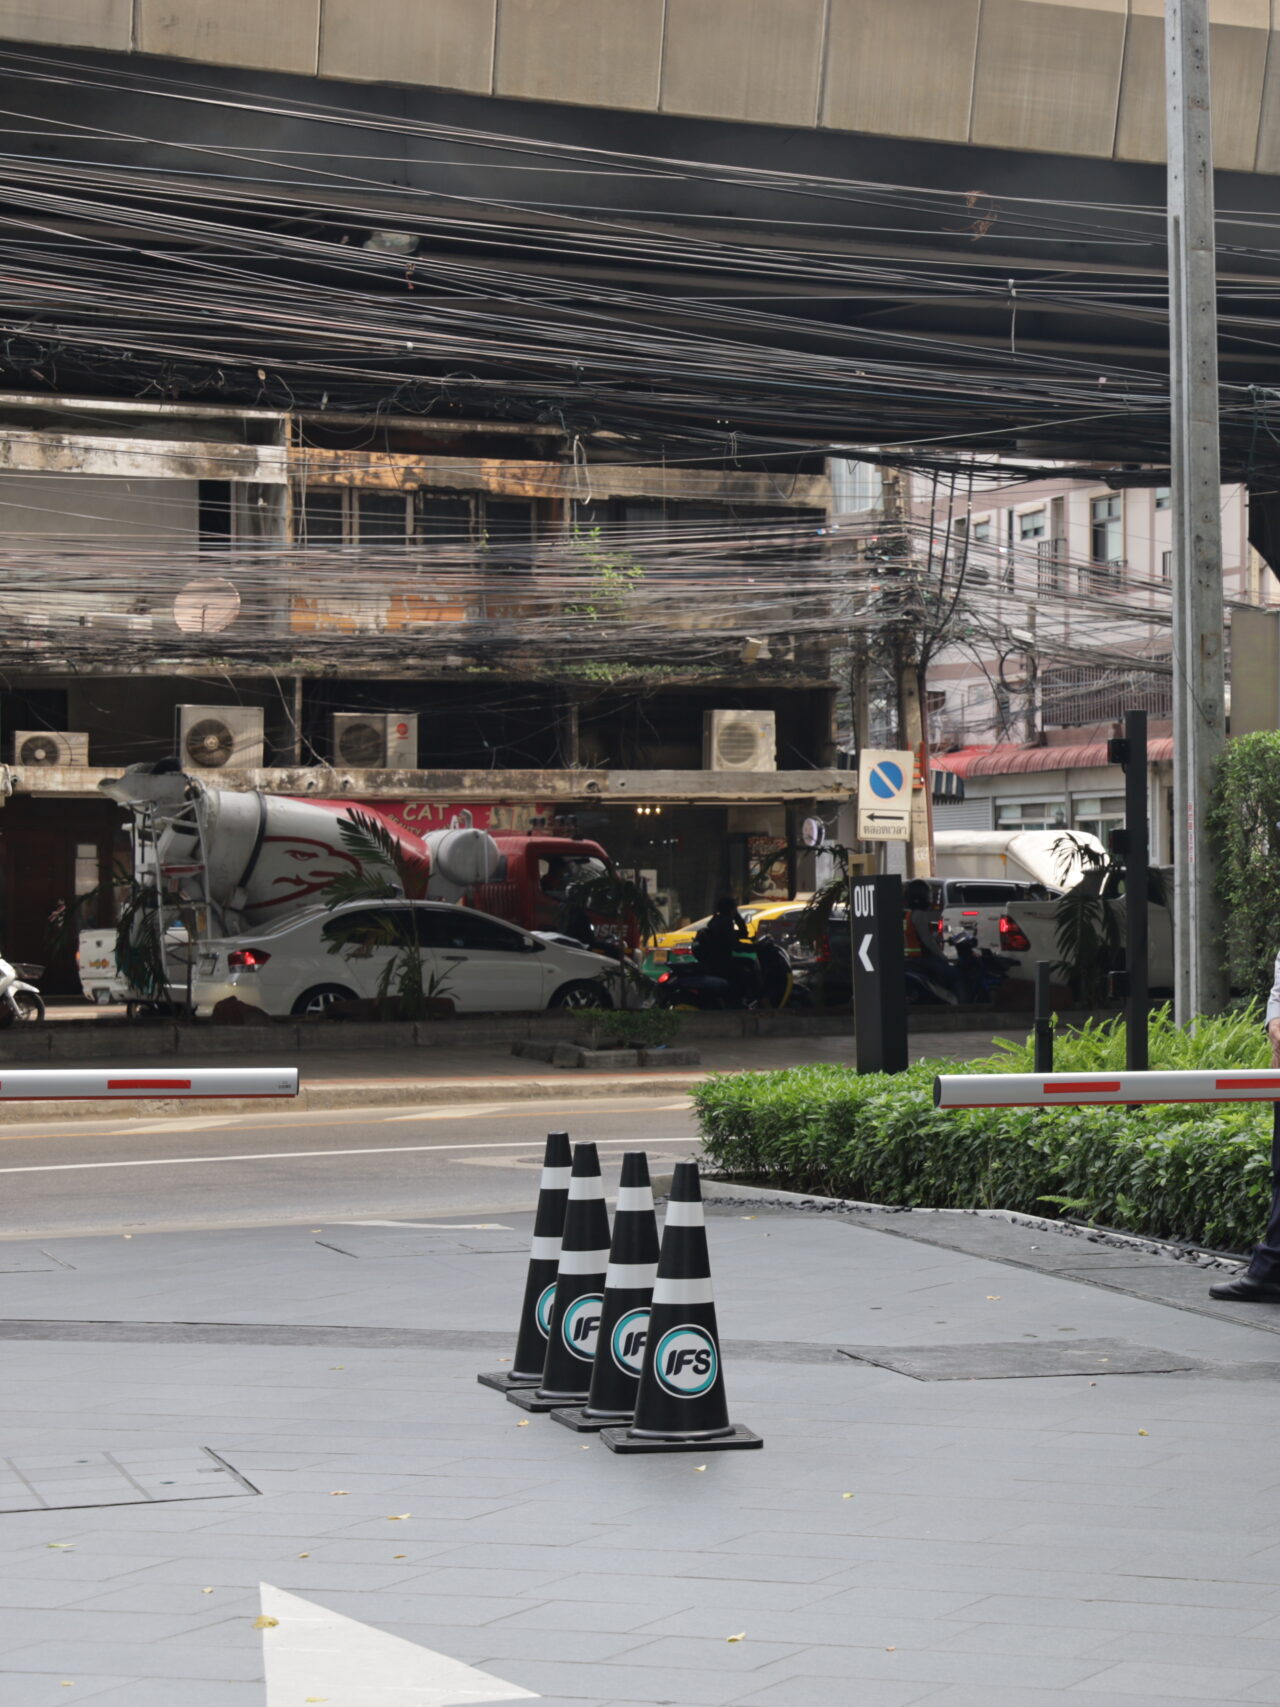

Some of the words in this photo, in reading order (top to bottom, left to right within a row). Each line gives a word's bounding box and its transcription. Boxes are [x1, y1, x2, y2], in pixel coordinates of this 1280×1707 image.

[403, 804, 450, 821] CAT
[854, 885, 875, 917] OUT
[573, 1316, 600, 1341] IF
[623, 1332, 647, 1357] IF
[665, 1349, 711, 1376] IFS
